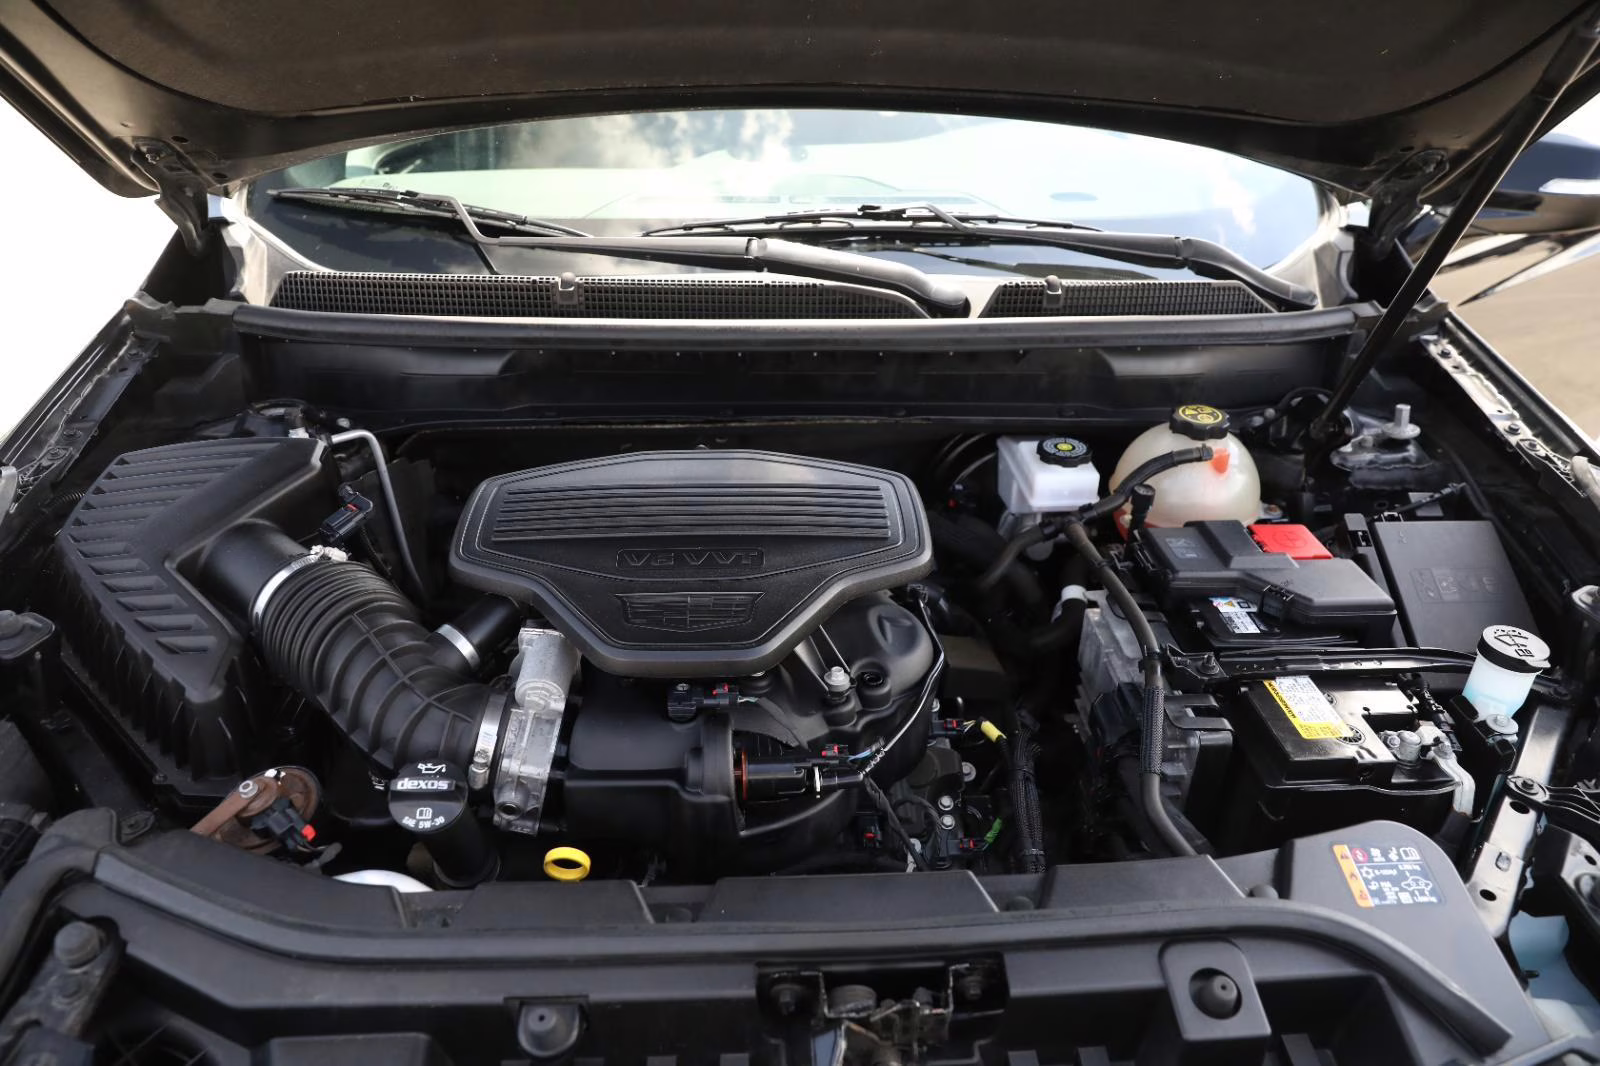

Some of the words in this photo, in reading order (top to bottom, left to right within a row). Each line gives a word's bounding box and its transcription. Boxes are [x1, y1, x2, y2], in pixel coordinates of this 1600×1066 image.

[623, 552, 674, 566] V6
[682, 551, 758, 565] VVT
[396, 777, 451, 790] dexos
[402, 816, 417, 827] SAE
[418, 816, 445, 829] 5W-30
